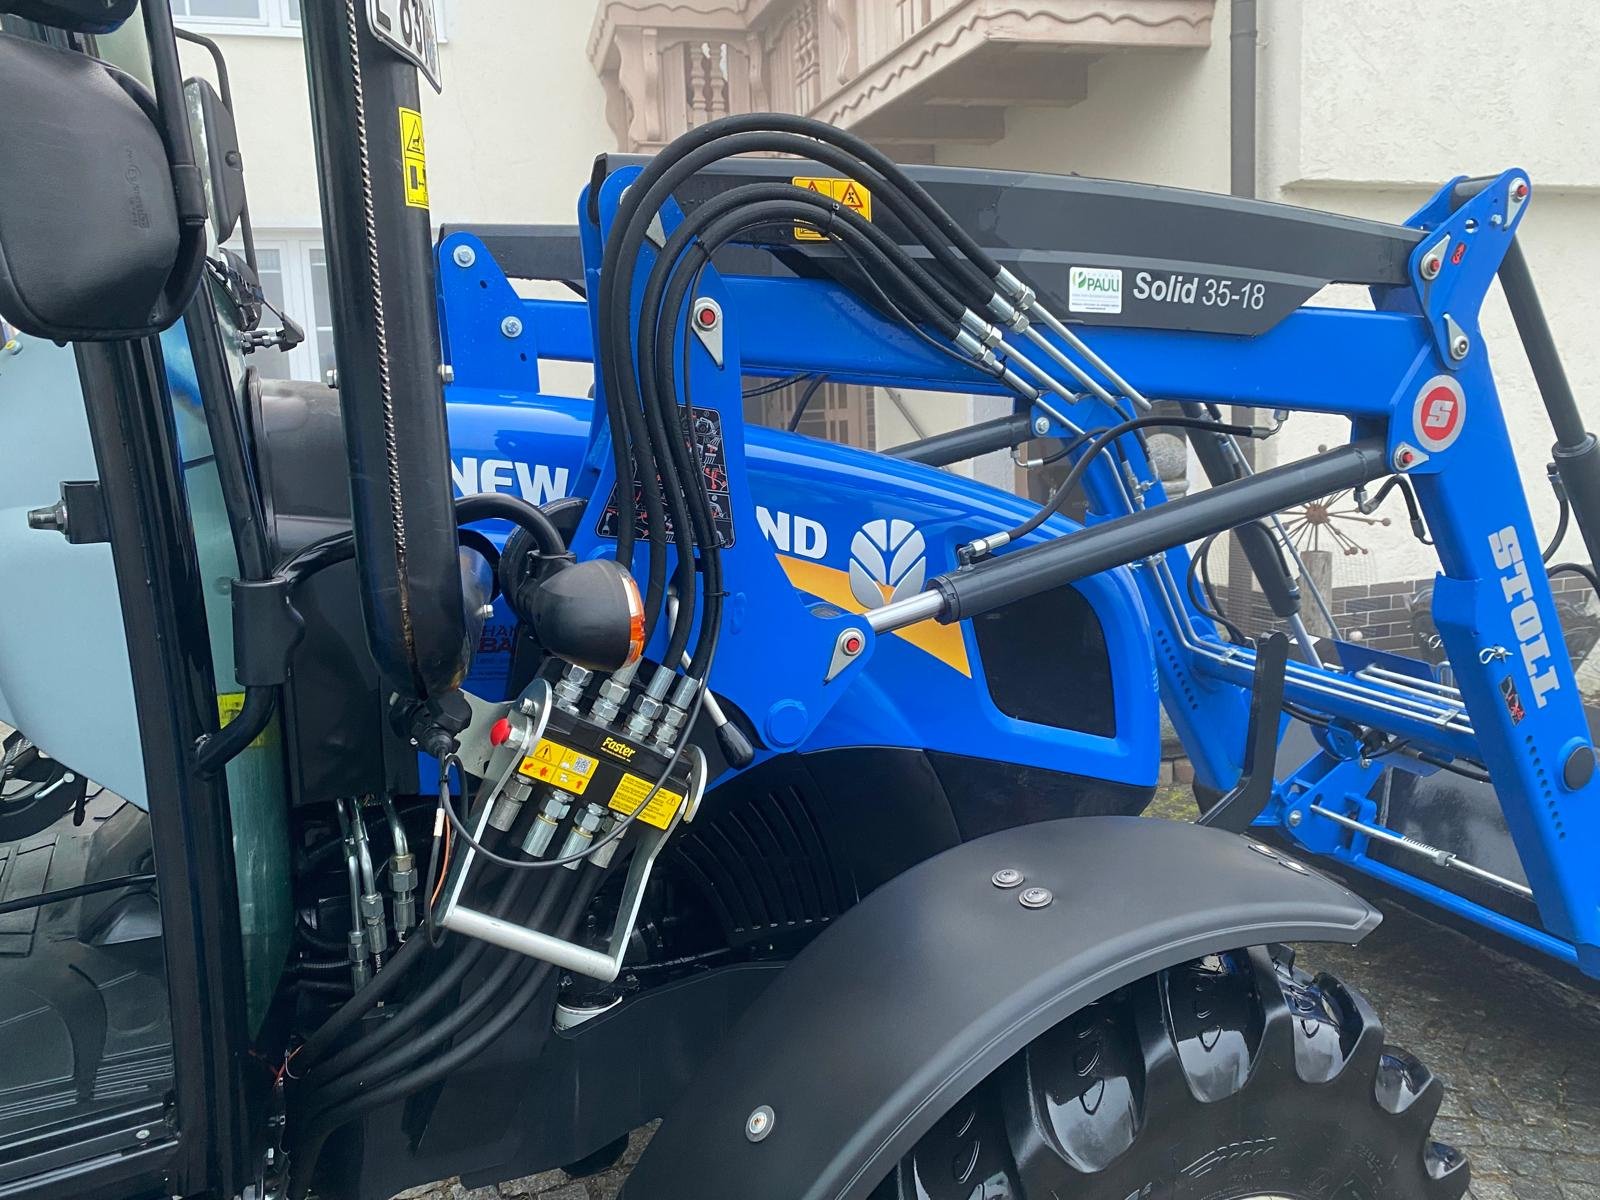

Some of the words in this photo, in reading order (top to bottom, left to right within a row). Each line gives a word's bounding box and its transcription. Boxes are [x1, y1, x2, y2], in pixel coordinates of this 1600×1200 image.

[1133, 272, 1199, 304] Solid
[1202, 278, 1266, 310] 35-18
[1425, 399, 1454, 428] S
[1488, 525, 1561, 709] STOLL
[602, 736, 637, 758] Faster
